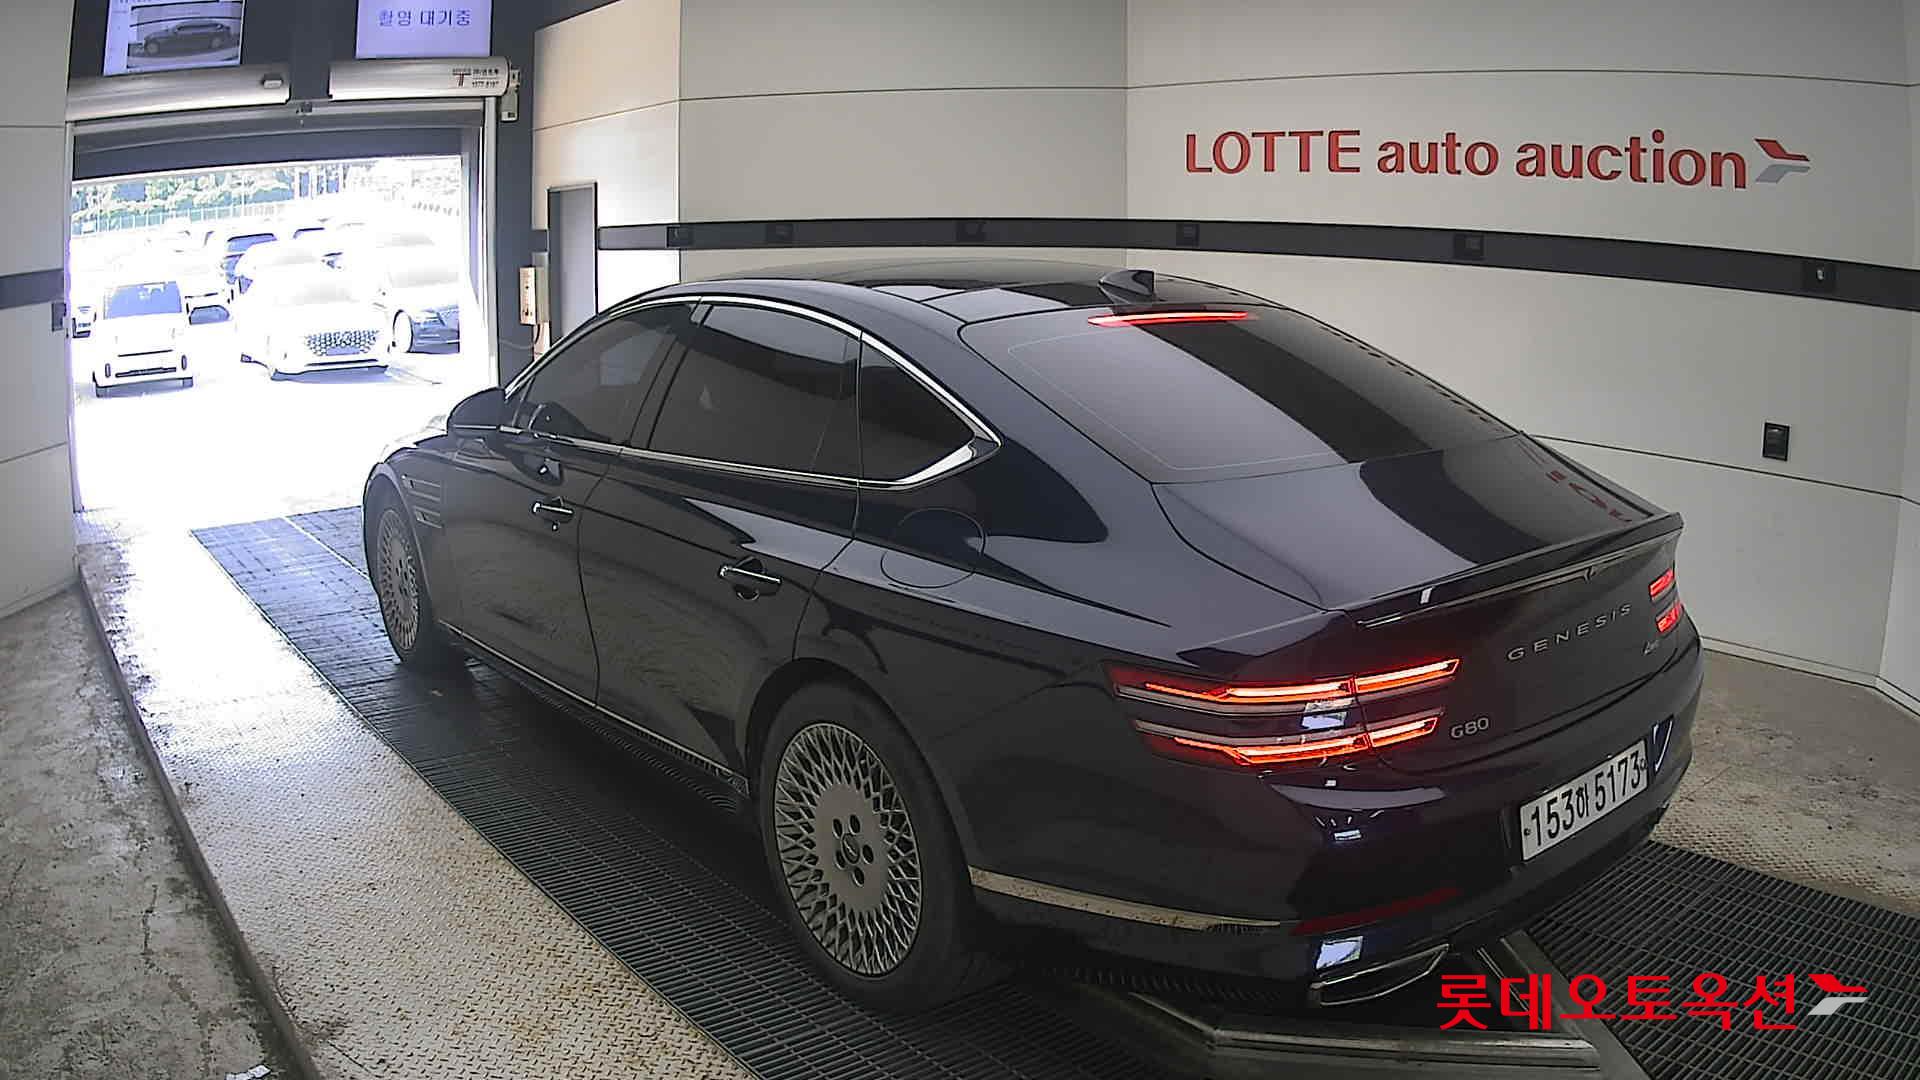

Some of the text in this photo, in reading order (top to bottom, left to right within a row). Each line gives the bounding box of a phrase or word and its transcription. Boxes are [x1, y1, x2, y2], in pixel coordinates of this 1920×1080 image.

[420, 9, 471, 27] 대기중
[1185, 129, 1748, 189] LOTTE auto auction
[1507, 603, 1632, 662] GENESIS
[1449, 716, 1491, 739] G80
[1594, 750, 1642, 812] 5173
